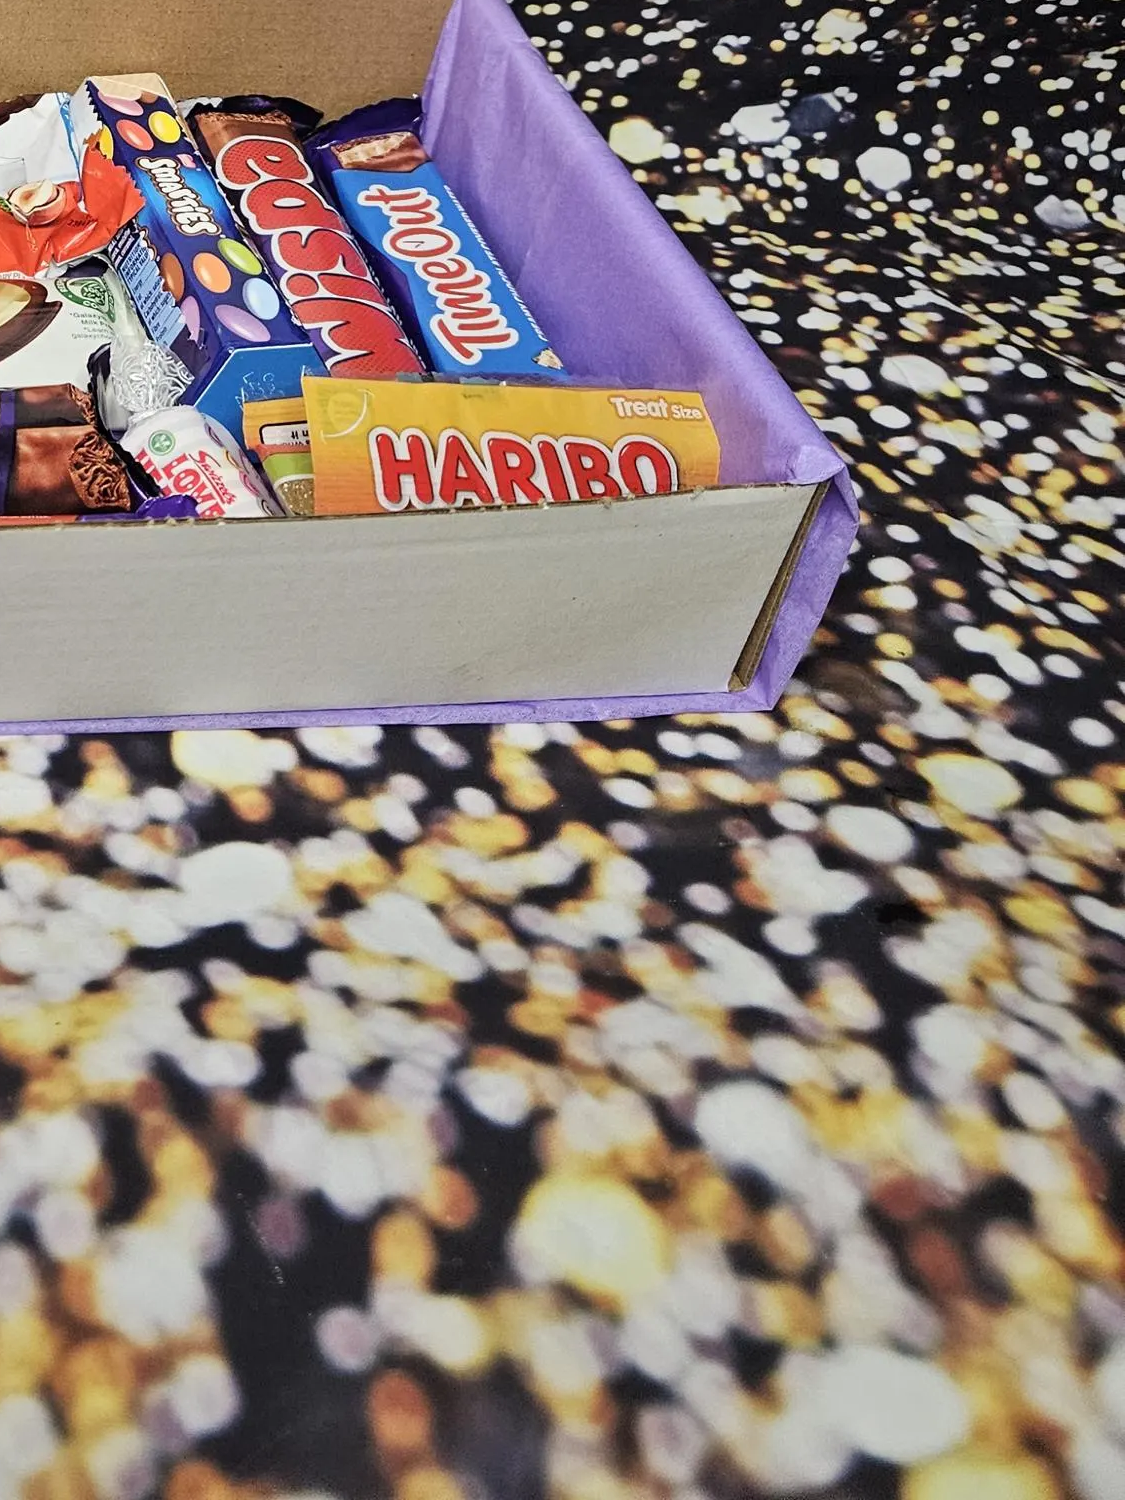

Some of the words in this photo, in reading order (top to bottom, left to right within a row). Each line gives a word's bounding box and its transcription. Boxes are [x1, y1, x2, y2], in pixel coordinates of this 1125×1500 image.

[215, 135, 426, 378] Wispa
[357, 184, 519, 365] TimeOut
[610, 396, 668, 419] Treat
[671, 404, 703, 420] Size
[162, 452, 226, 517] LOVE
[368, 426, 678, 512] HARIBO
